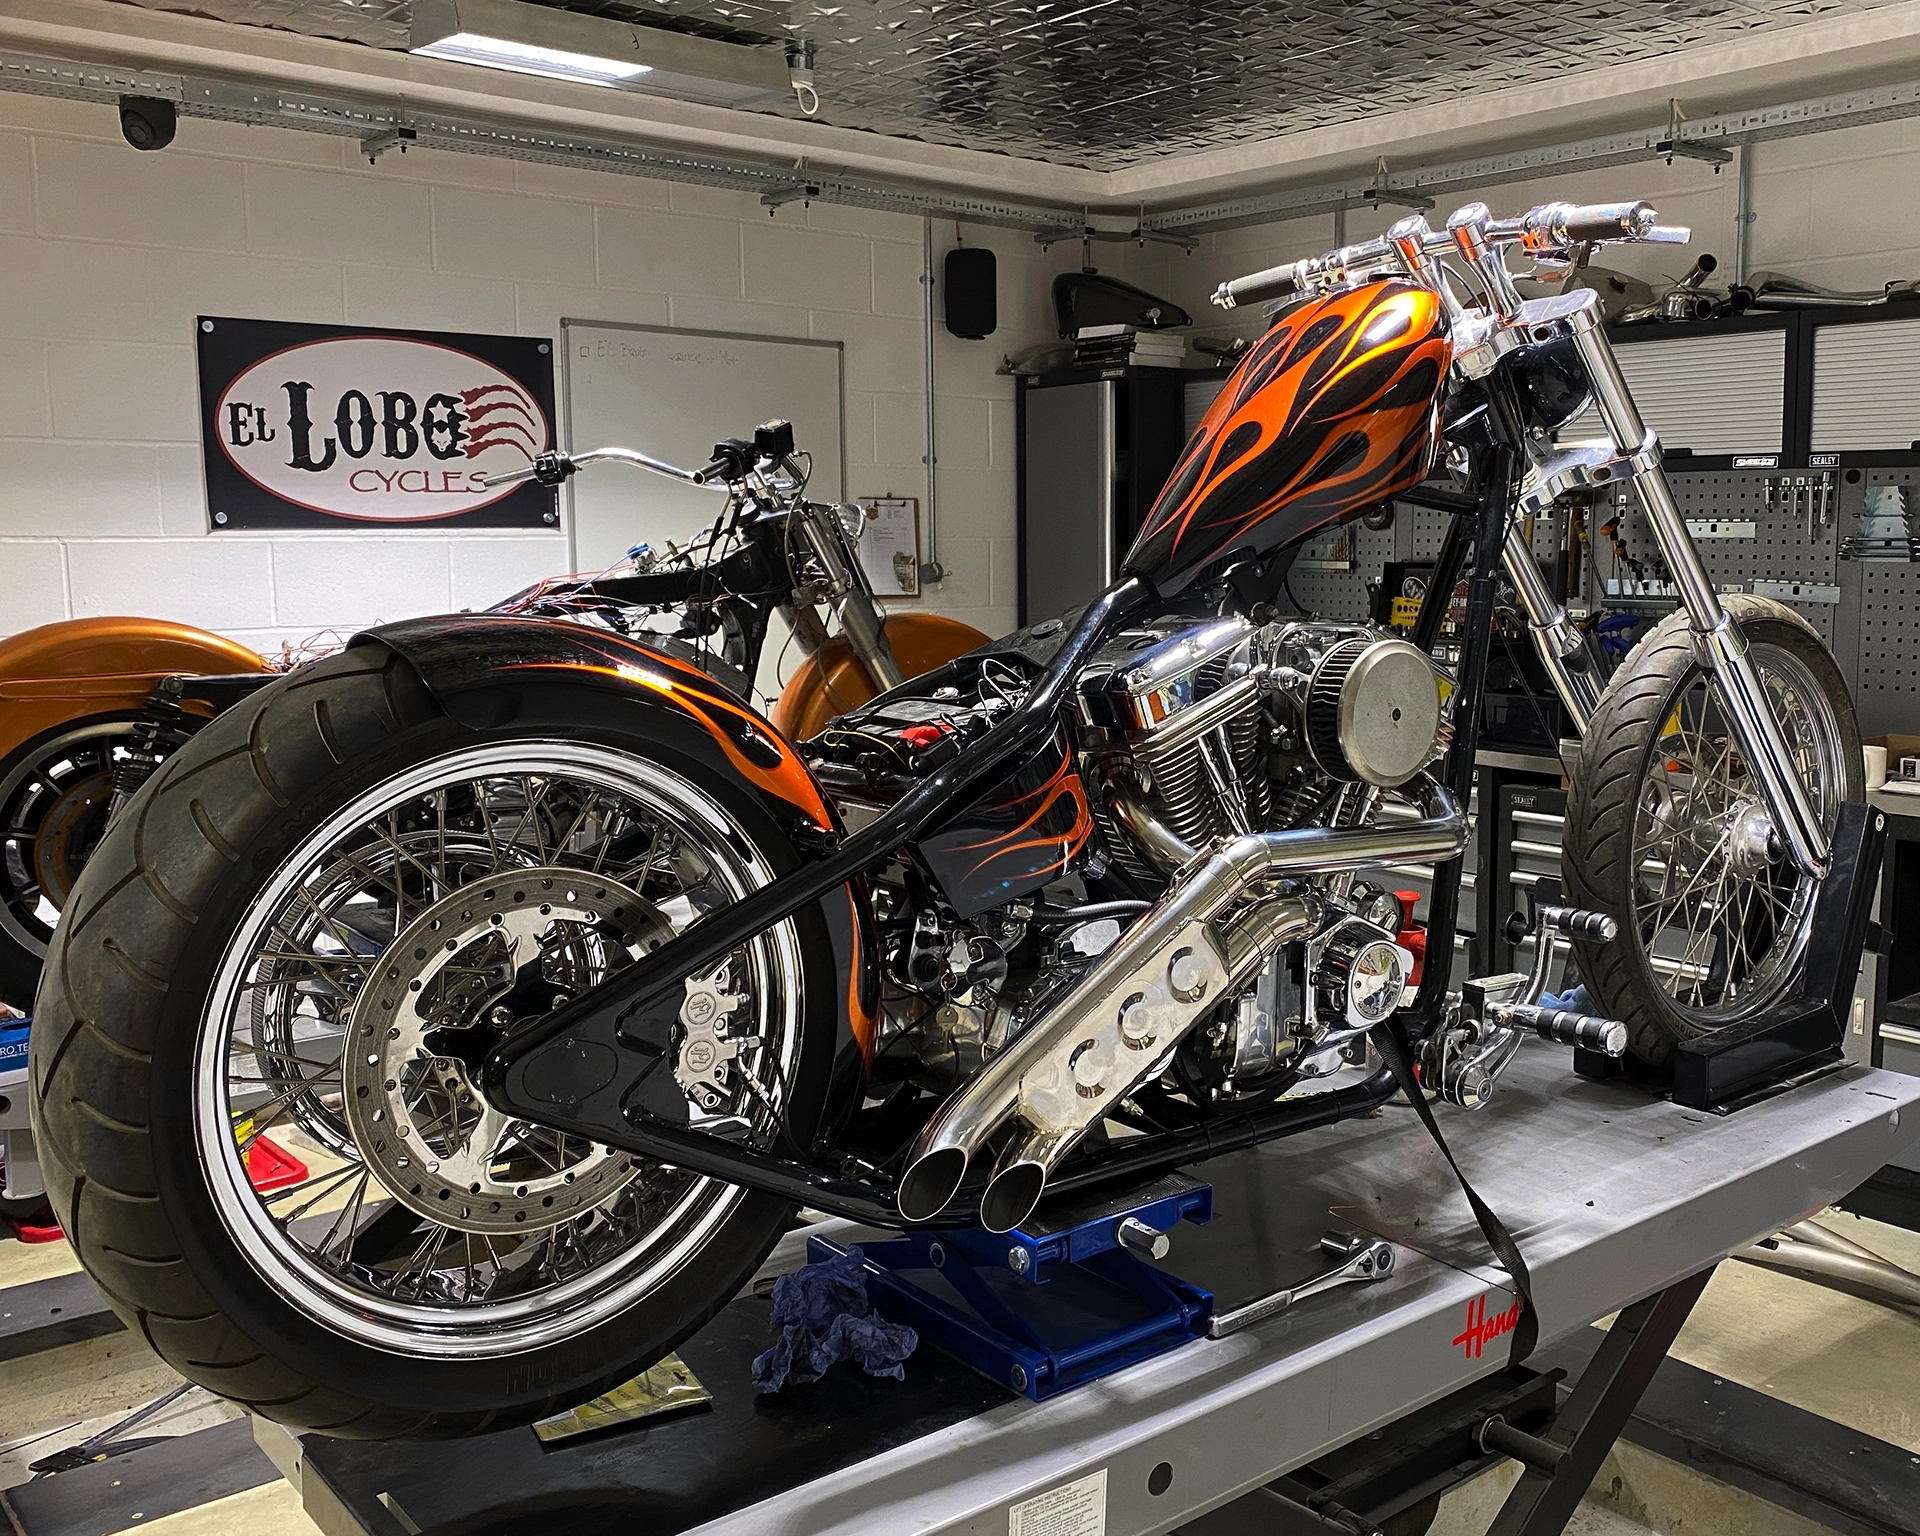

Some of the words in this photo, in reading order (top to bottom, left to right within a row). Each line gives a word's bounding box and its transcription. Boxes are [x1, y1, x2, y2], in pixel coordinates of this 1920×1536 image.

[226, 402, 275, 446] EL
[280, 381, 468, 472] LOBO
[1812, 456, 1837, 466] SEALEY
[349, 469, 489, 493] CYCLES
[0, 1043, 29, 1056] RO.TE
[1452, 1290, 1519, 1359] Hand
